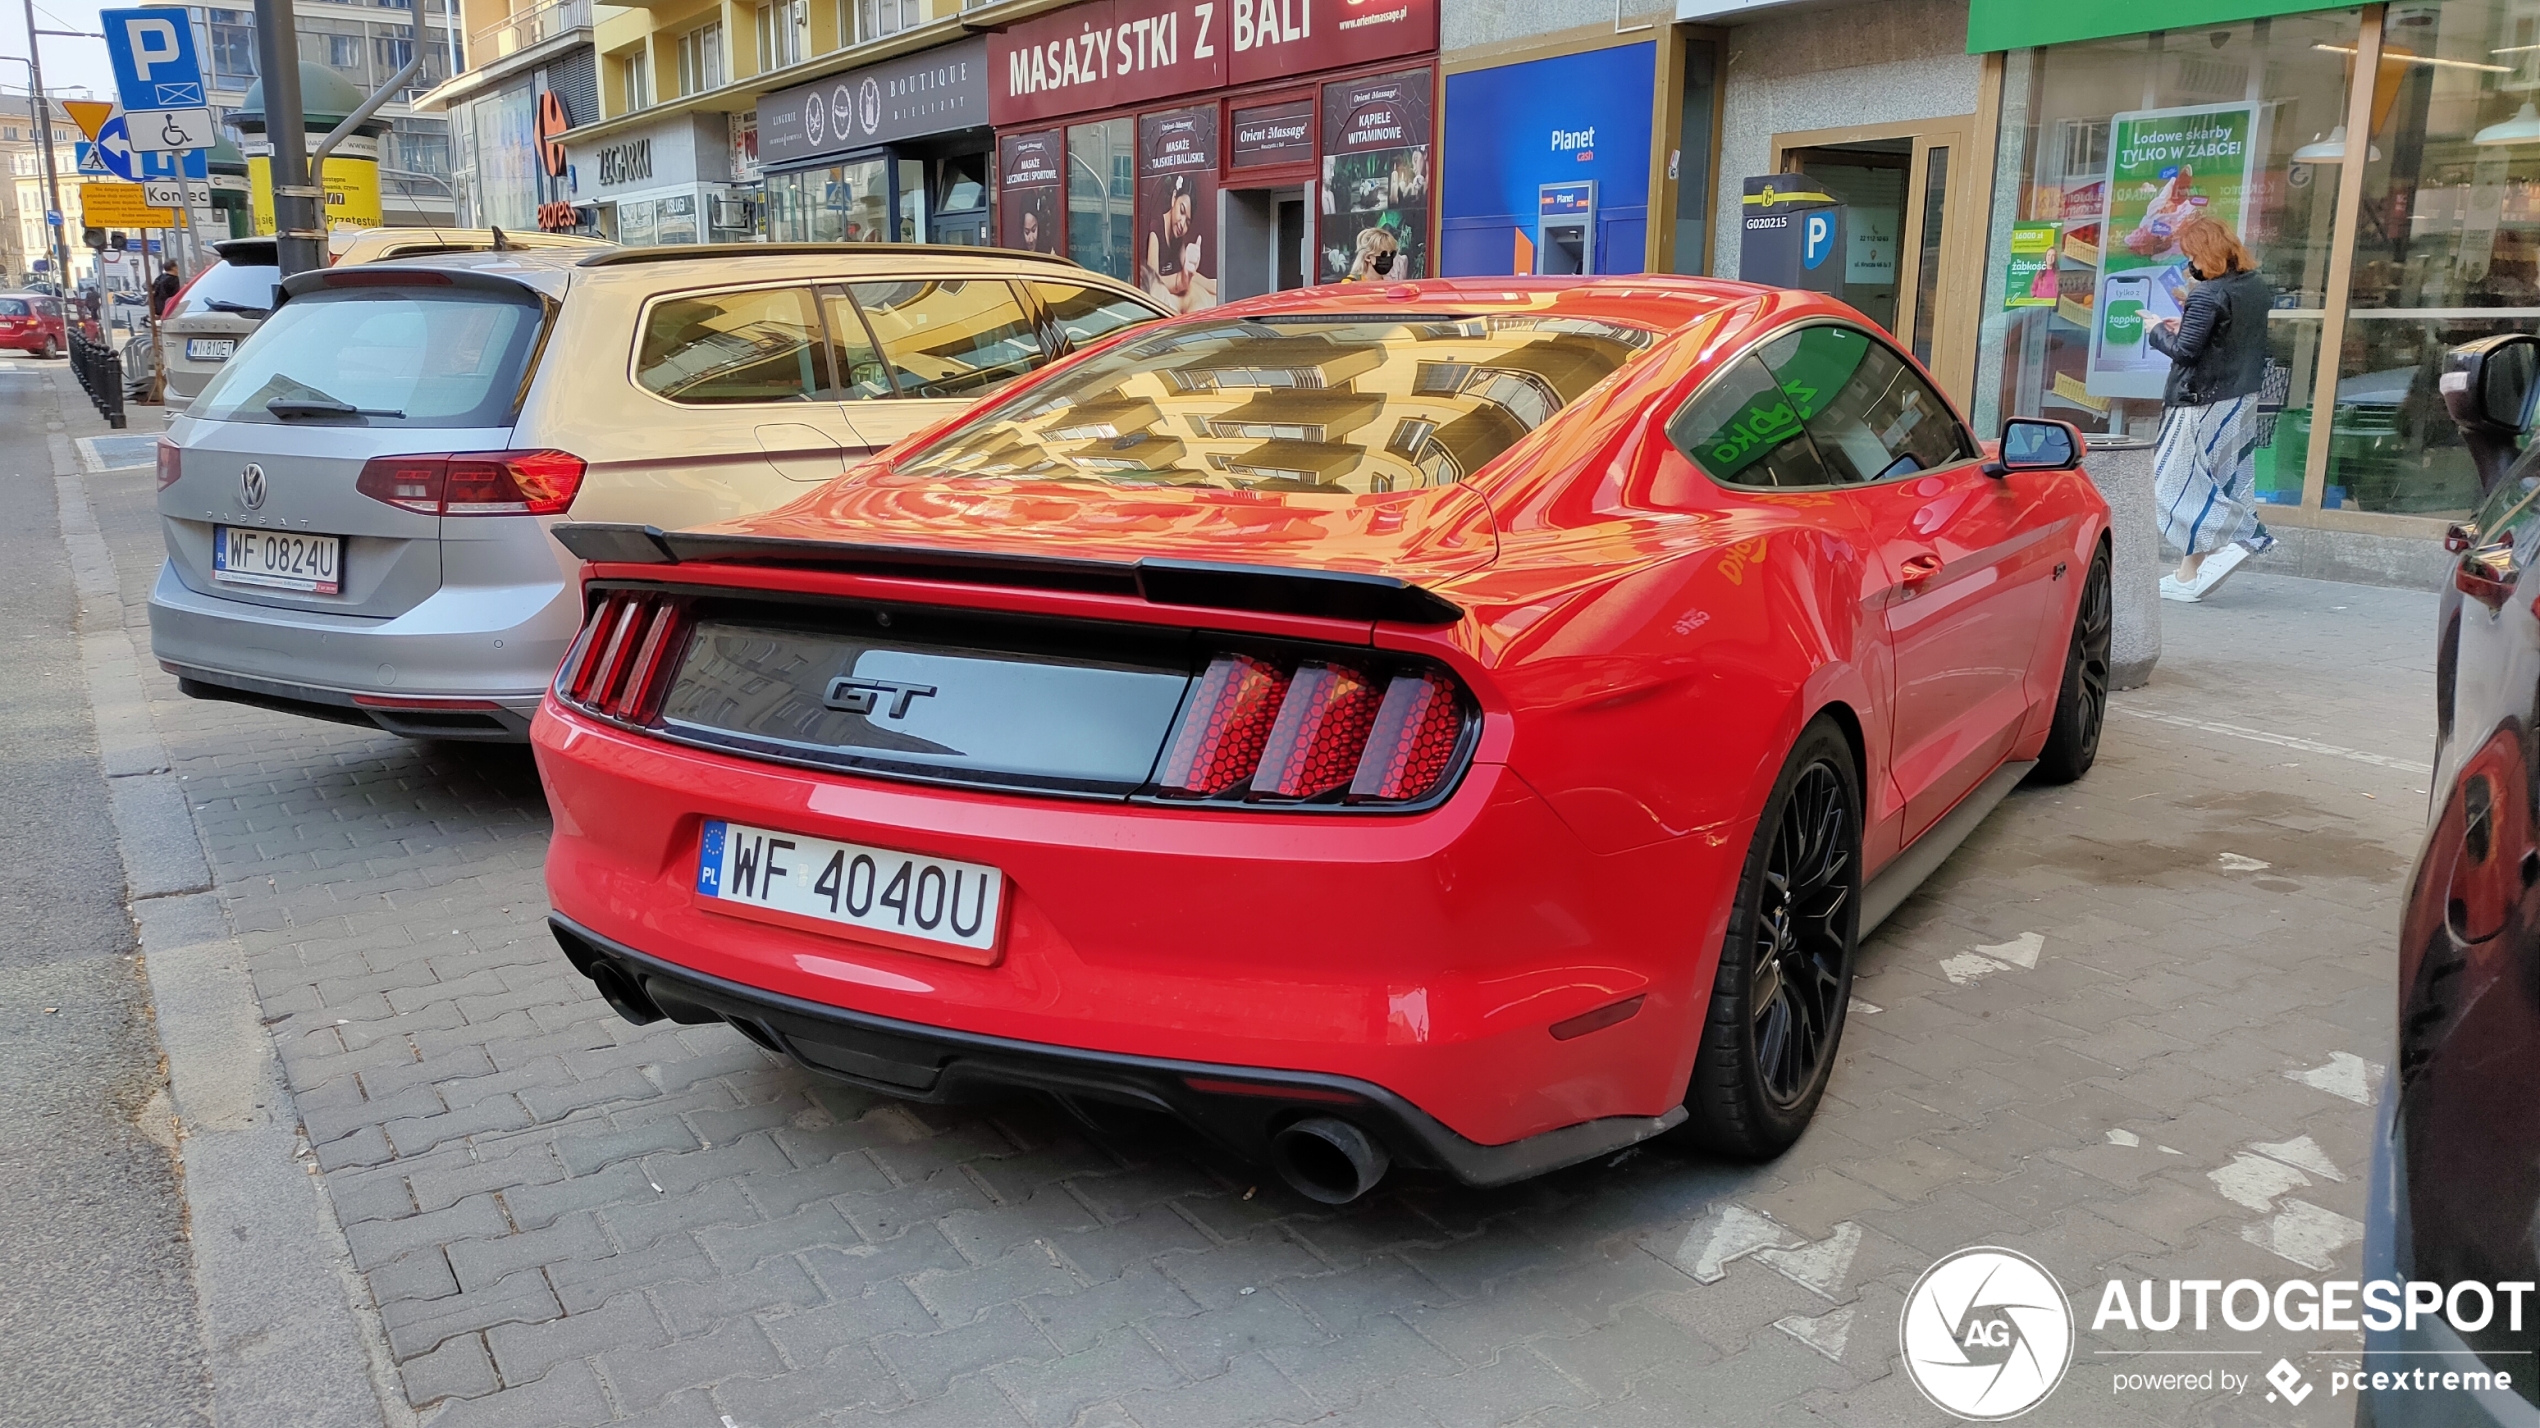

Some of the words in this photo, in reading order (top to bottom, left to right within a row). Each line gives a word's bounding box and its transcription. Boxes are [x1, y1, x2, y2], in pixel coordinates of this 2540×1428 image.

[1339, 5, 1408, 31] www.orientmassage.pl
[125, 18, 180, 81] P
[1010, 12, 1177, 97] MASAŻYSTKI
[1194, 2, 1214, 59] Z
[1234, 0, 1311, 52] BALI
[890, 62, 967, 98] BOUTIQUE
[1353, 92, 1371, 103] Orient
[1371, 88, 1397, 99] Massage
[894, 96, 965, 121] BIELIZNY
[772, 111, 797, 126] LINGERIE
[1358, 111, 1391, 128] KĄPIELE
[1240, 128, 1266, 143] Orient
[1267, 124, 1306, 140] Massage
[1347, 126, 1402, 145] WITAMINOWE
[1551, 126, 1596, 151] Planet
[2133, 131, 2183, 145] Lodowe
[2185, 125, 2233, 141] skarby
[1165, 138, 1190, 153] MASAŻE
[2122, 148, 2167, 163] TYLKO
[2170, 145, 2185, 159] W
[2186, 141, 2242, 158] ŻABCE!
[597, 139, 653, 186] ZEGARKI
[1021, 157, 1041, 170] MASAŻE
[1151, 155, 1174, 169] TAJSKIE
[1176, 152, 1205, 165] BALIJSKIE
[1576, 150, 1594, 162] cash
[1006, 171, 1029, 185] LECZNICZE
[1031, 169, 1057, 181] SPORTOWE
[147, 187, 208, 202] Konec
[1556, 193, 1574, 204] Planet
[261, 214, 274, 227] się
[537, 201, 577, 230] express
[1746, 216, 1788, 230] G020215
[1808, 217, 1827, 259] P
[2015, 231, 2036, 240] 16000
[2011, 261, 2047, 271] żabkość
[2115, 288, 2135, 298] tylko
[206, 511, 309, 529] PASSAT
[217, 552, 226, 563] PL
[230, 532, 257, 568] WF
[265, 536, 334, 577] 0824U
[822, 676, 938, 719] GT
[701, 866, 718, 886] PL
[732, 832, 796, 900] WF
[813, 849, 988, 938] 4040U
